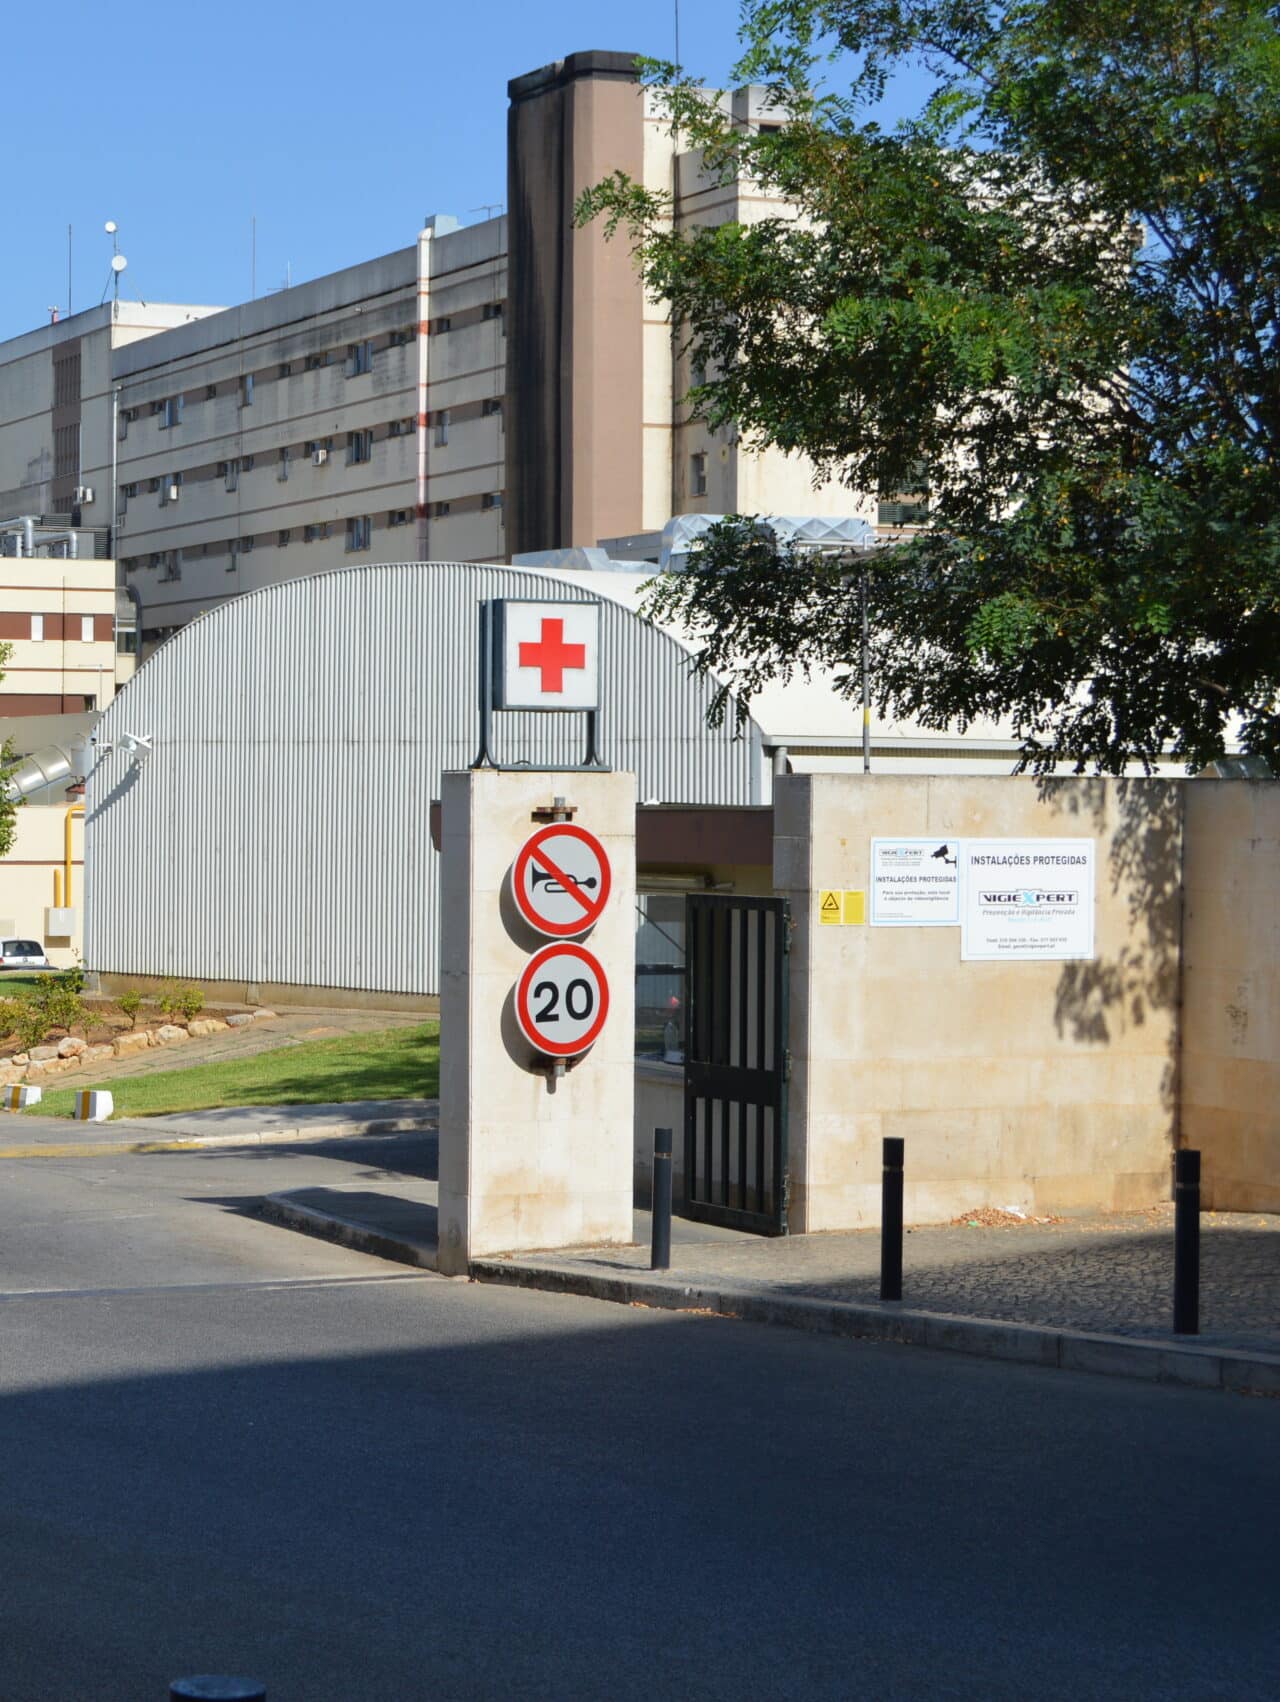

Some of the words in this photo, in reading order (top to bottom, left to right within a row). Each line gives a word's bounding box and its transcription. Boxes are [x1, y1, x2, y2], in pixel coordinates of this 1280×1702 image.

[970, 853, 1031, 867] INSTALAÇÕES
[1033, 855, 1087, 865] PROTEGIDAS
[876, 875, 917, 883] INSTALAÇÕES
[919, 875, 956, 883] PROTEGIDAS
[983, 892, 1075, 904] VIGIEXPERT
[533, 978, 593, 1023] 20
